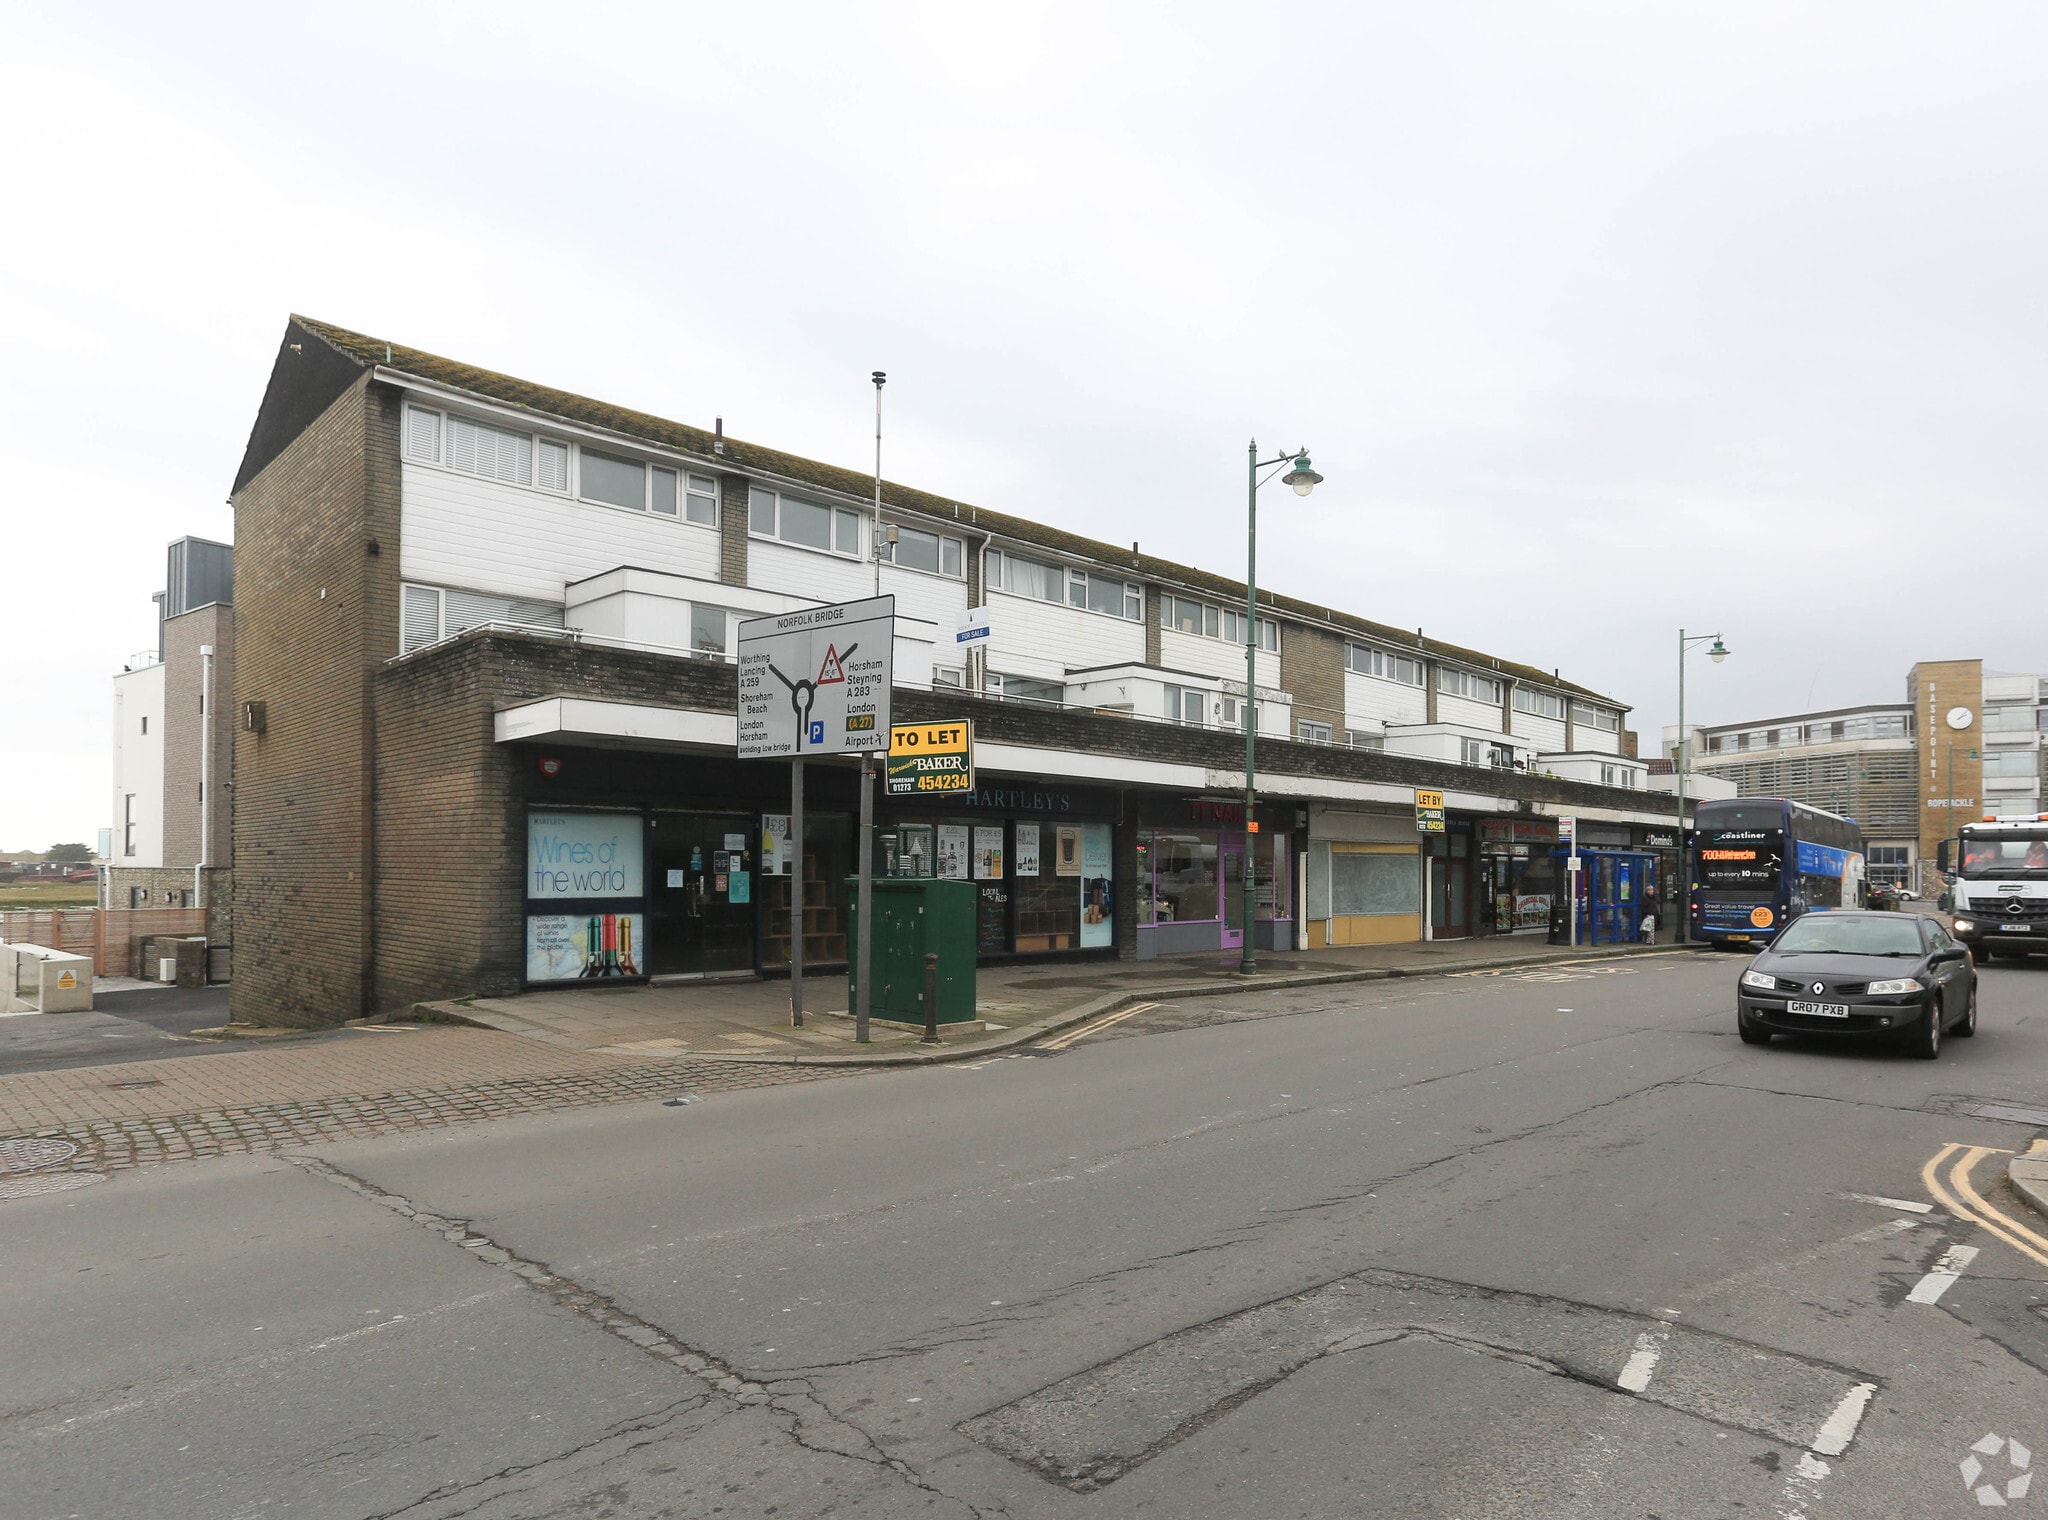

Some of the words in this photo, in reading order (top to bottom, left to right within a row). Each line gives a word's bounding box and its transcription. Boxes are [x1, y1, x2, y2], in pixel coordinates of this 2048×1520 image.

[778, 614, 813, 629] NORFOLK
[815, 608, 844, 622] BRIDGE
[962, 632, 970, 640] FOR
[971, 629, 984, 637] SALE
[740, 654, 770, 664] Worthing
[740, 666, 765, 676] Lancing
[848, 659, 882, 672] Horsham
[740, 680, 745, 688] A
[746, 677, 759, 687] 259
[847, 673, 882, 685] Steyning
[740, 692, 773, 703] Shoreham
[847, 688, 852, 698] A
[854, 686, 870, 697] 283
[747, 704, 767, 714] Beach
[847, 702, 875, 713] London
[740, 720, 763, 730] London
[1929, 682, 1937, 778] BASEPOINT
[740, 732, 768, 741] Horsham
[813, 725, 820, 740] P
[895, 732, 919, 746] TO
[928, 730, 960, 745] LET
[845, 735, 873, 748] Airport
[739, 745, 761, 753] avoiding
[773, 743, 791, 752] bridge
[912, 756, 968, 771] BAKER
[917, 774, 968, 790] 454234
[966, 789, 1070, 811] HARTLEY'S
[1419, 795, 1430, 804] LET
[1433, 796, 1441, 805] BY
[1928, 799, 1974, 807] ROPEACKLE
[534, 835, 594, 864] Wines
[598, 835, 618, 864] of
[534, 864, 569, 892] the
[573, 864, 625, 892] world
[1792, 1002, 1819, 1013] GR07
[1823, 1005, 1844, 1015] PXB
